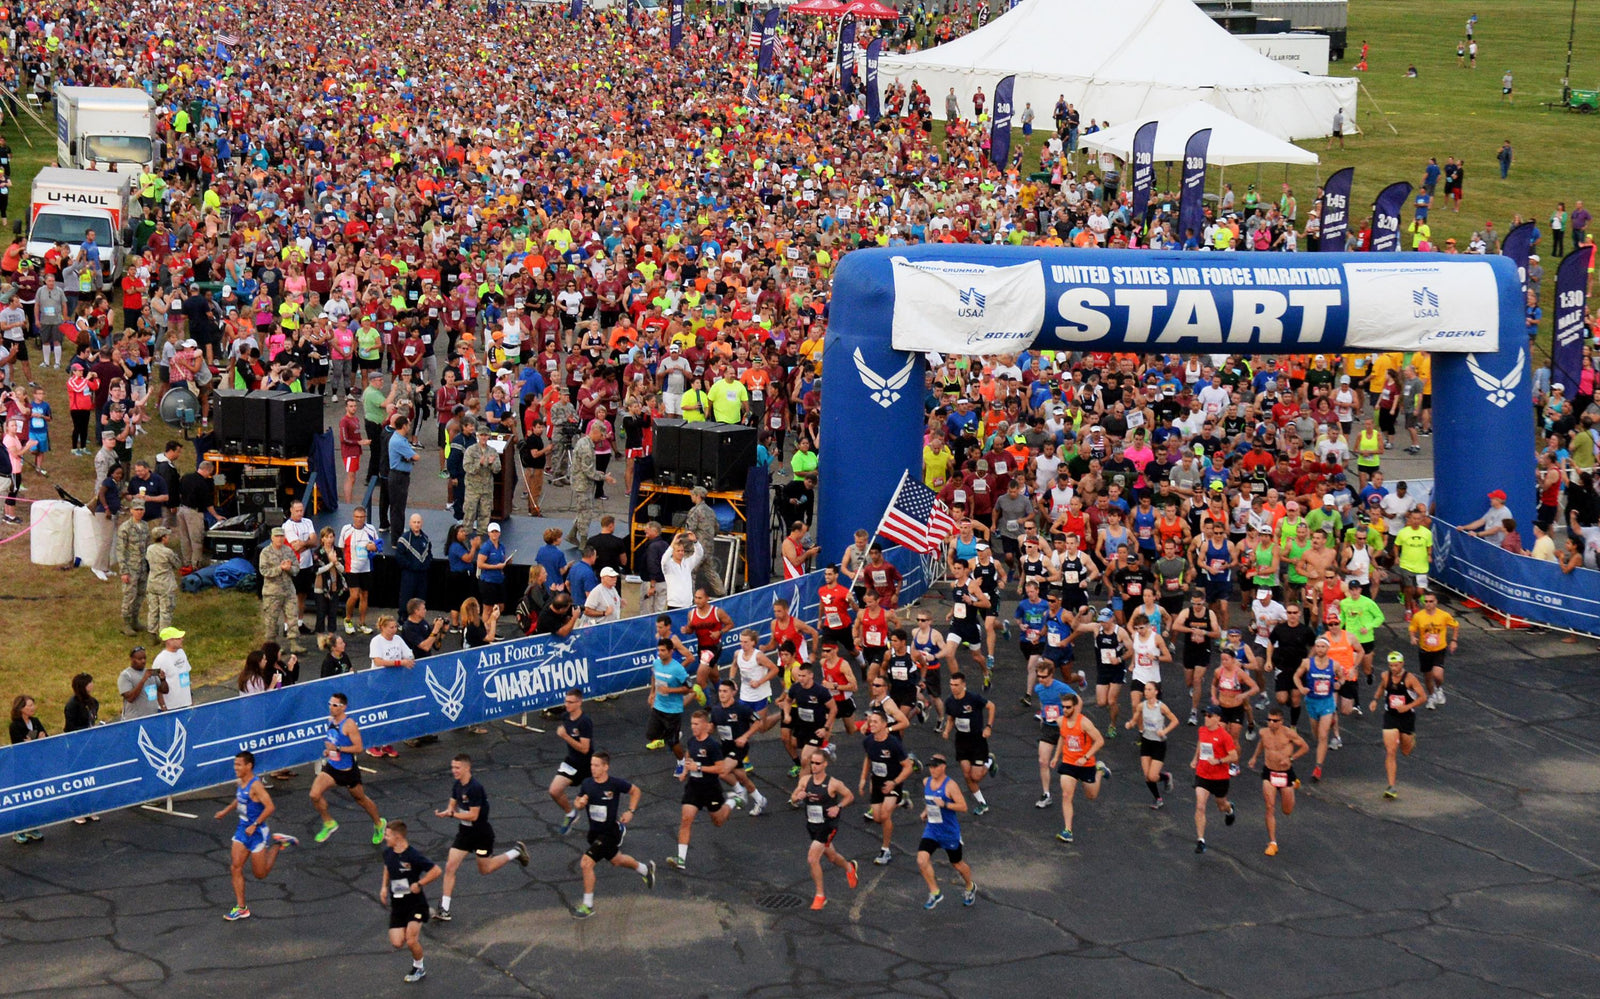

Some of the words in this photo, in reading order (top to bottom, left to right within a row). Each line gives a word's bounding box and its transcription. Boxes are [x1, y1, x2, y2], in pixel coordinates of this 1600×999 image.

[1136, 151, 1151, 165] 2:00
[1186, 156, 1204, 170] 3:30
[48, 192, 108, 205] U-HAUL
[1325, 192, 1346, 209] 1:45
[1324, 211, 1345, 225] HALF
[1377, 213, 1399, 232] 3:20
[1051, 265, 1110, 284] UNITED
[1112, 266, 1170, 285] STATES
[1173, 267, 1200, 285] AIR
[1201, 267, 1253, 285] FORCE
[1255, 267, 1342, 285] MARATHON
[1559, 289, 1584, 308] 1:30
[958, 308, 984, 318] USAA
[1055, 287, 1342, 343] START
[1413, 308, 1440, 319] USAA
[1558, 309, 1582, 330] HALF
[984, 330, 1034, 340] BOEING
[1435, 330, 1486, 338] BOEING
[477, 650, 502, 669] AIR
[504, 643, 544, 663] FORCE
[494, 657, 589, 703] MARATHON
[522, 698, 538, 707] HALF
[239, 710, 388, 752] USAFMARAT.COM
[0, 776, 96, 806] ATHON.COM
